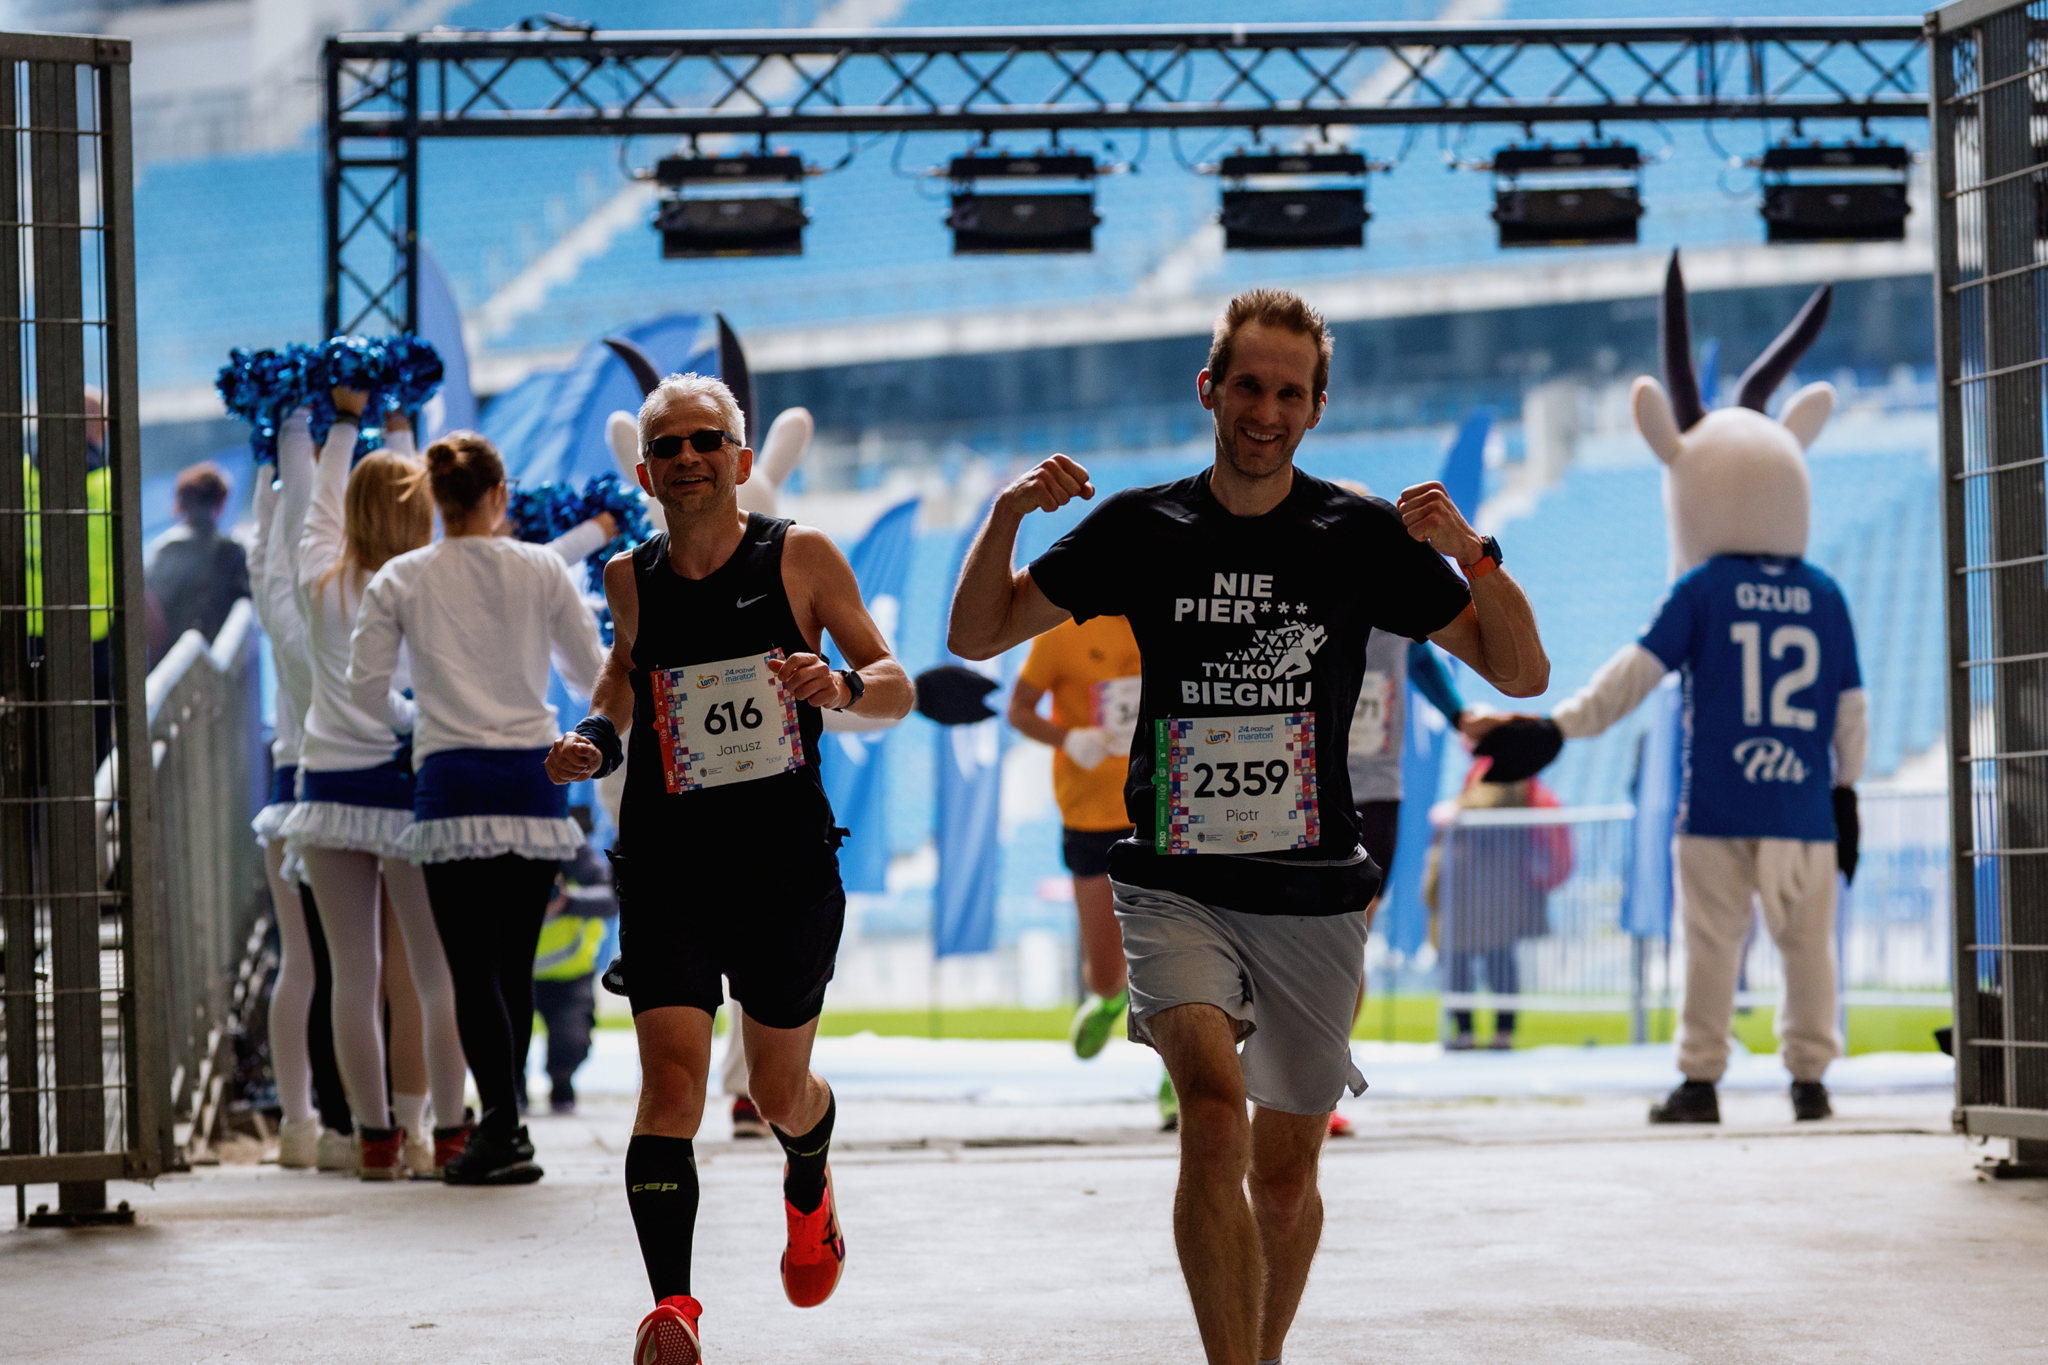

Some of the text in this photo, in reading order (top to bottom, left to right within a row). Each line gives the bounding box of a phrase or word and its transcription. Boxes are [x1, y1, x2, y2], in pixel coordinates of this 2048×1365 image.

[1213, 572, 1273, 598] NIE
[725, 672, 757, 682] maraton
[1202, 662, 1272, 679] TYLKO
[1729, 621, 1820, 731] 12
[1181, 680, 1312, 707] BIEGNIJ
[704, 697, 763, 735] 616
[1238, 732, 1274, 741] maraton
[716, 741, 762, 757] Janusz
[667, 770, 675, 786] M50
[1193, 759, 1289, 798] 2359
[1226, 809, 1260, 822] Piotr
[1159, 831, 1167, 847] M30
